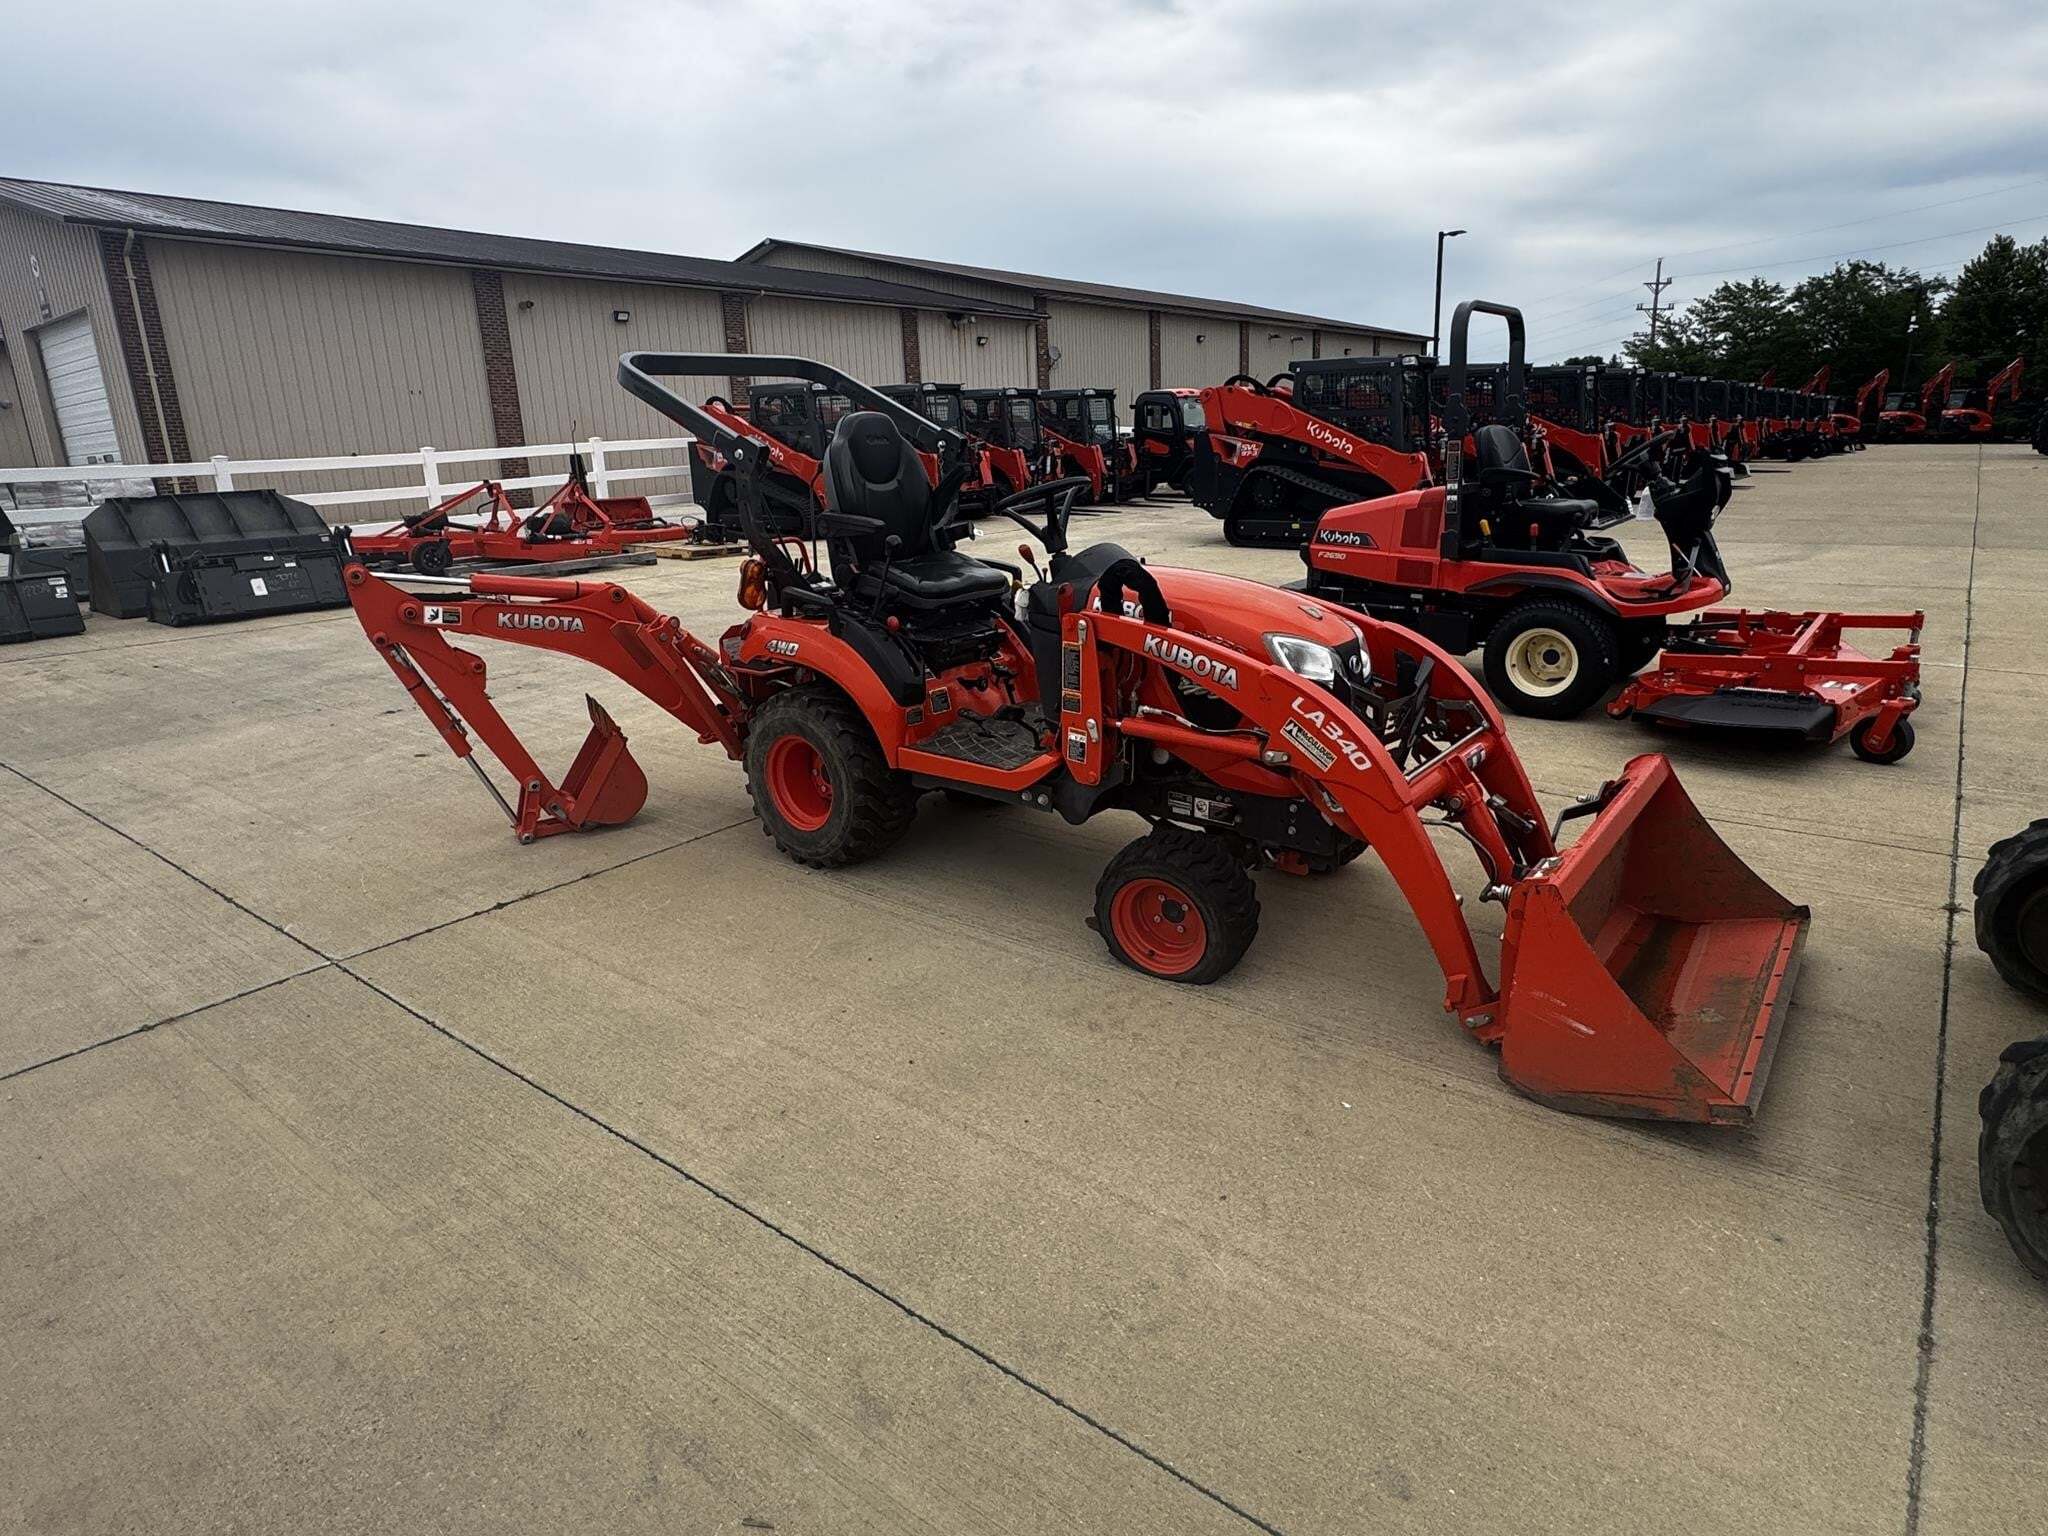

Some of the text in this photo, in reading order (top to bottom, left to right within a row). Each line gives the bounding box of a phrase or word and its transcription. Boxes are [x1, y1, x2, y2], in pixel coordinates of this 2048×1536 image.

[1307, 421, 1353, 455] Kubota
[1320, 529, 1361, 545] Kubota
[497, 612, 585, 633] KUBOTA
[767, 639, 800, 656] 4WD
[1143, 632, 1239, 690] KUBOTA
[1291, 696, 1372, 771] LA340
